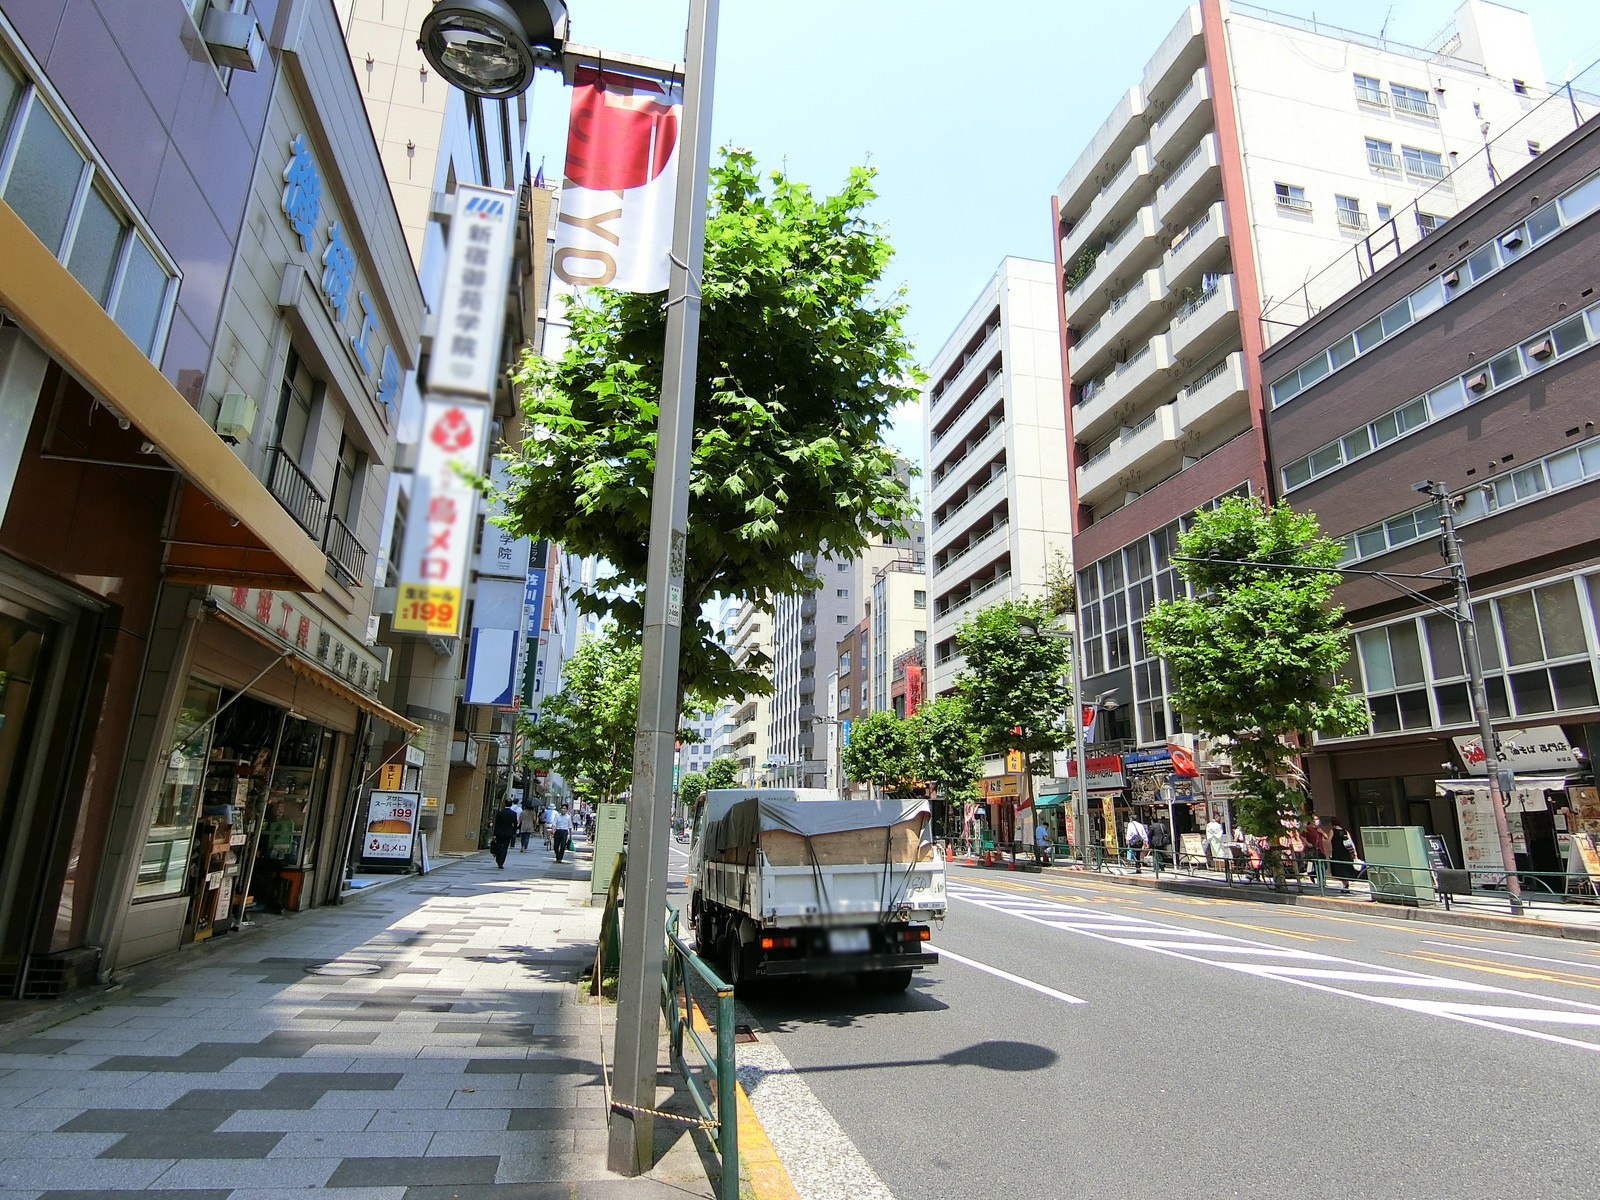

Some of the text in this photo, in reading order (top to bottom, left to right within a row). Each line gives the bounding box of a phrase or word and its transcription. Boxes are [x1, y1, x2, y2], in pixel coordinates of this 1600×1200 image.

[410, 601, 454, 623] 199
[387, 765, 396, 790] 生ビー
[392, 808, 412, 818] 199
